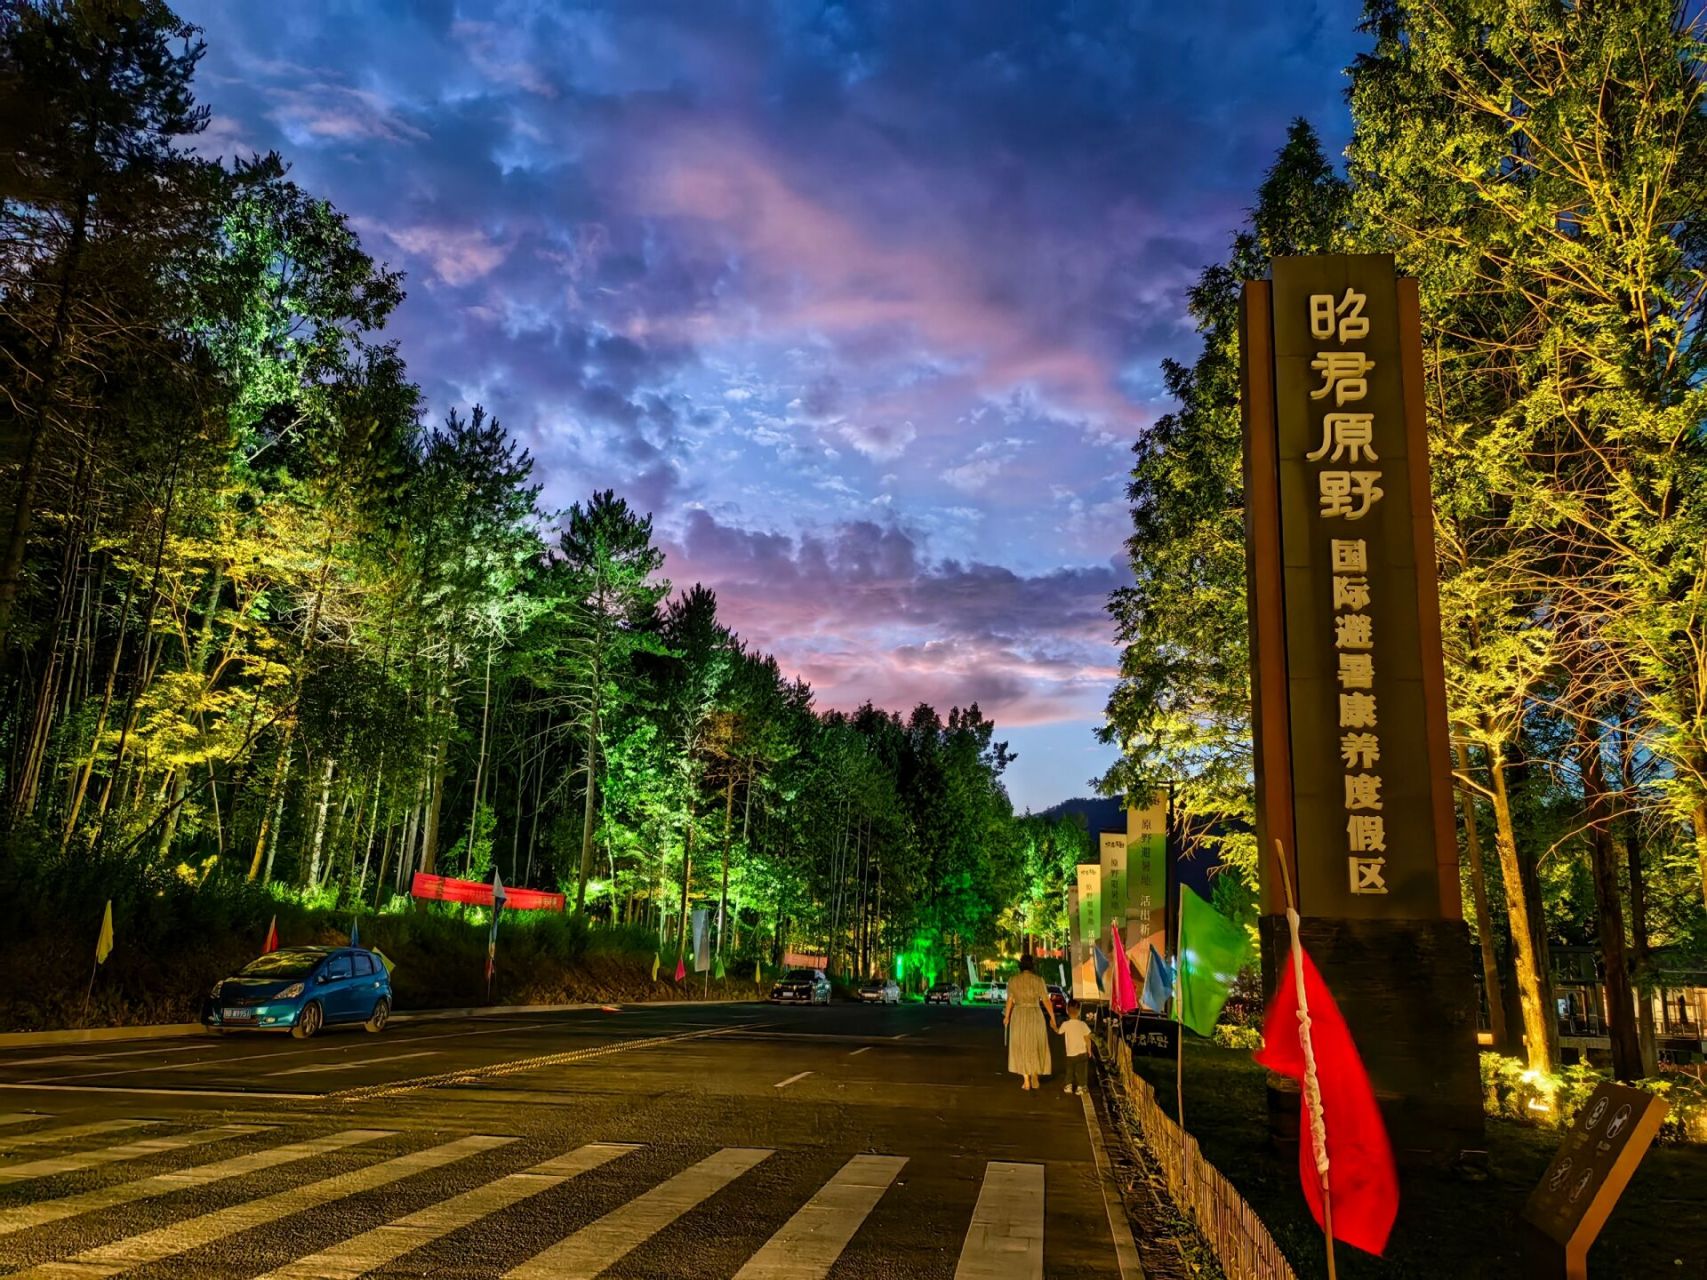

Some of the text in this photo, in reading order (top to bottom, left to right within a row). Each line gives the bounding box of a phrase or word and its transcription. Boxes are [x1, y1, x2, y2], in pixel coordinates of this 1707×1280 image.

[1306, 287, 1385, 520] 昭君原野
[1331, 538, 1389, 895] 国际避暑康养度假区
